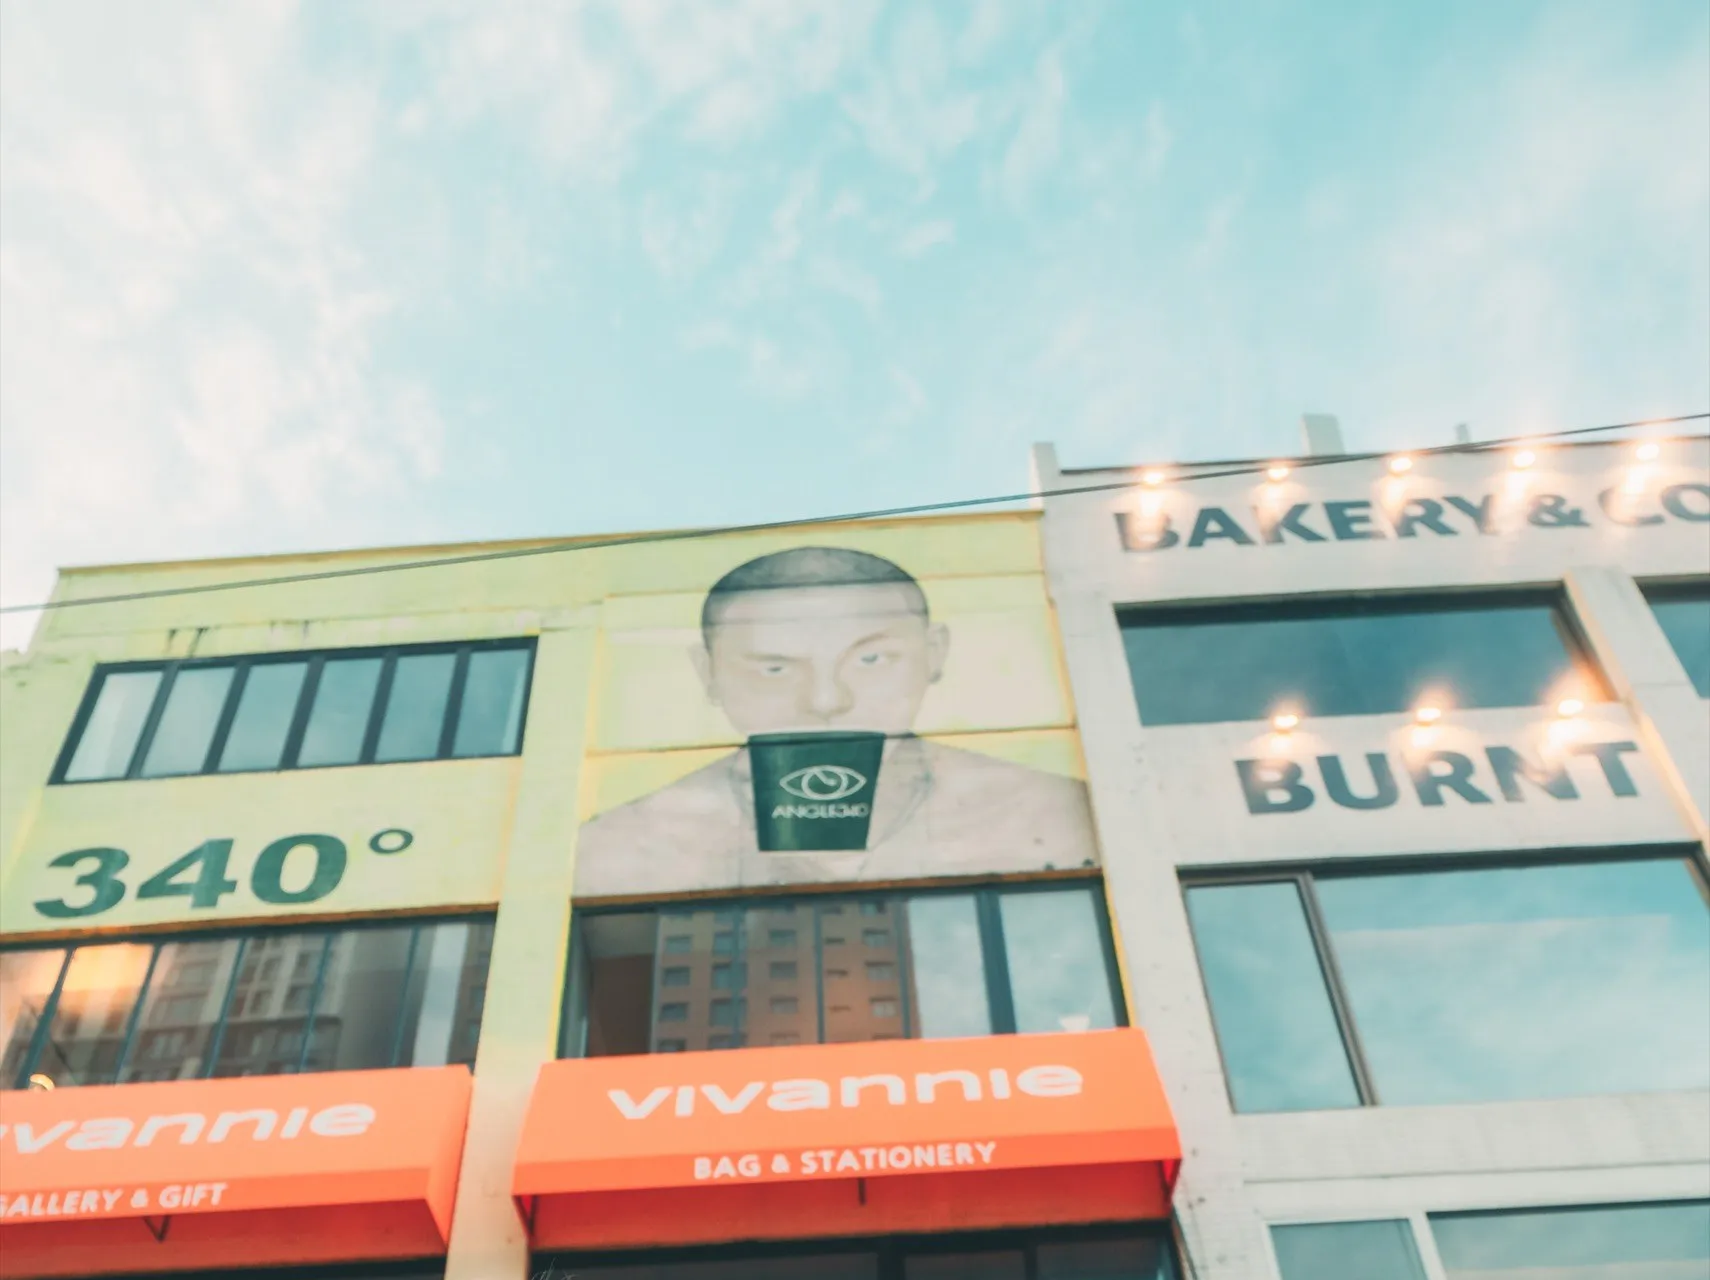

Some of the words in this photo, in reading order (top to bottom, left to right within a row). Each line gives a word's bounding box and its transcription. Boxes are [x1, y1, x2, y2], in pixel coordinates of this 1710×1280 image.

[1114, 494, 1499, 553] BAKERY
[1526, 493, 1590, 528] &
[1235, 742, 1640, 816] BURNT
[607, 1064, 1084, 1119] vivannie
[0, 1103, 376, 1155] vannie
[693, 1155, 761, 1181] BAG
[771, 1154, 792, 1174] &
[800, 1142, 997, 1175] STATIONERY
[129, 1188, 149, 1209] &
[158, 1182, 228, 1209] GIFT
